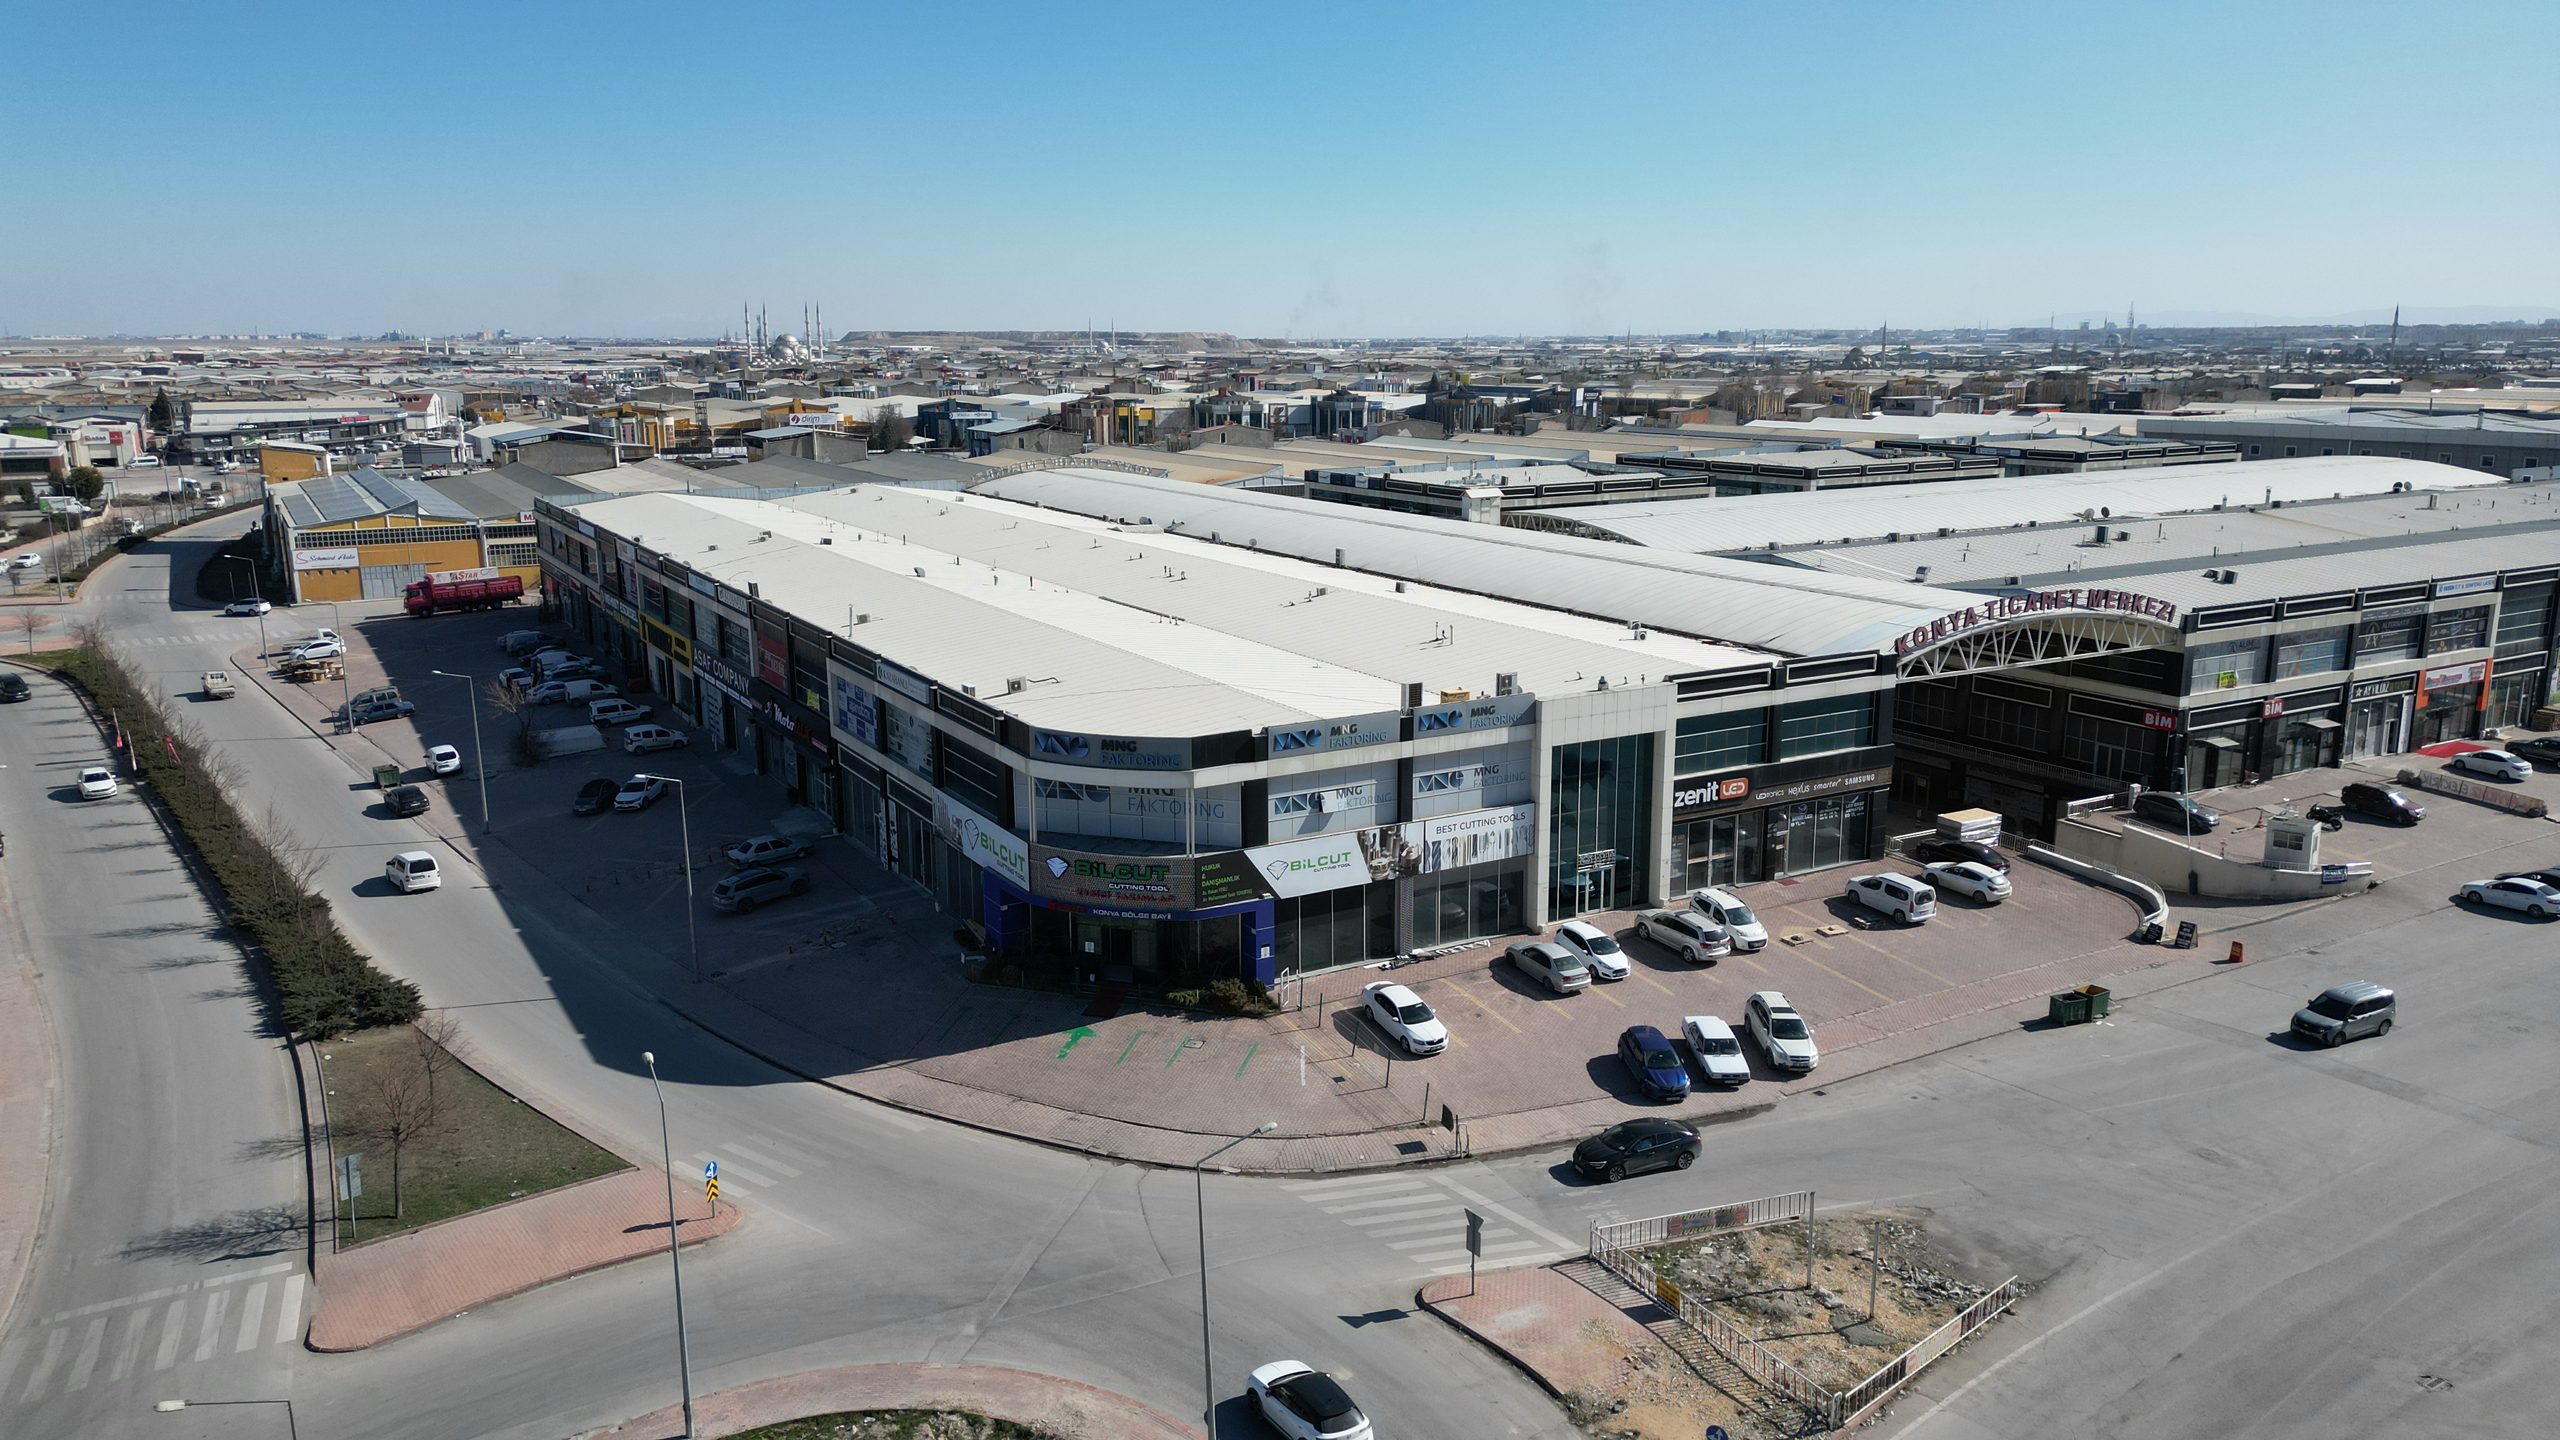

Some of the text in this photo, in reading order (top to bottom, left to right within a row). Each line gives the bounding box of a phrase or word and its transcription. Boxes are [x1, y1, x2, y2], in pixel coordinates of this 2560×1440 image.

[1894, 606, 1979, 654] KONYA
[693, 647, 712, 670] ASAF
[713, 658, 750, 696] COMPANY
[1470, 705, 1496, 718] MNG
[2264, 701, 2283, 716] BİM
[2144, 711, 2173, 729] BİM
[1329, 723, 1358, 736] MNG
[1100, 738, 1138, 752] MNG
[1473, 764, 1500, 777] MNG
[1844, 773, 1876, 786] SAMSUNG
[1336, 785, 1363, 800] MNG
[1673, 781, 1746, 808] zenit LED
[1436, 811, 1526, 835] BEST CUTTING TOOLS
[1313, 865, 1337, 873] CUTTING
[1108, 883, 1145, 891] CUTTING
[1092, 908, 1120, 918] KONYA
[1121, 910, 1150, 919] BÖLGE
